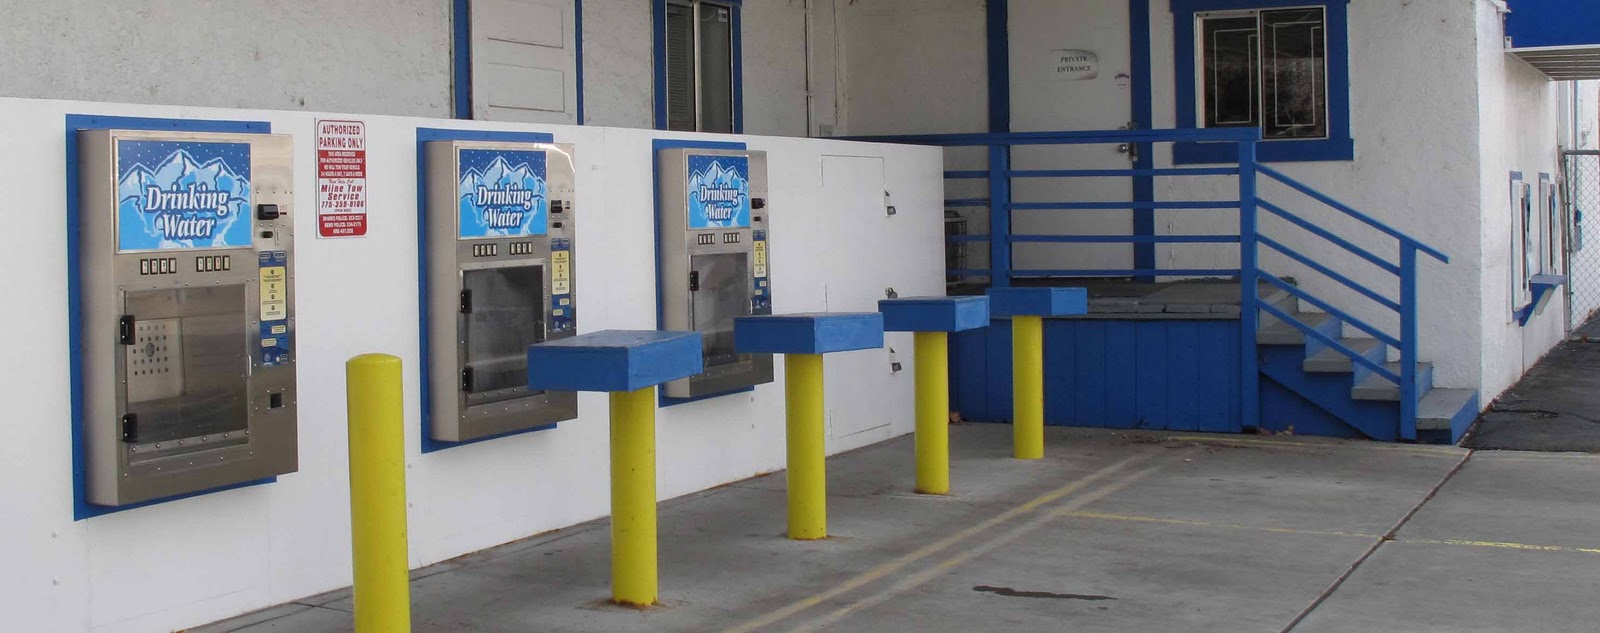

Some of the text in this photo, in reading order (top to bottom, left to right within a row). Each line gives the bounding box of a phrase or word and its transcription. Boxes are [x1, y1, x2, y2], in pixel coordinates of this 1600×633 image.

[322, 125, 360, 135] AUTHORIZED
[320, 137, 363, 148] PARKING ONLY
[145, 183, 229, 216] Drinking
[477, 183, 532, 209] Drinking
[700, 183, 738, 205] Drinking
[487, 208, 523, 227] Water
[708, 204, 732, 220] Water
[162, 213, 215, 237] Water
